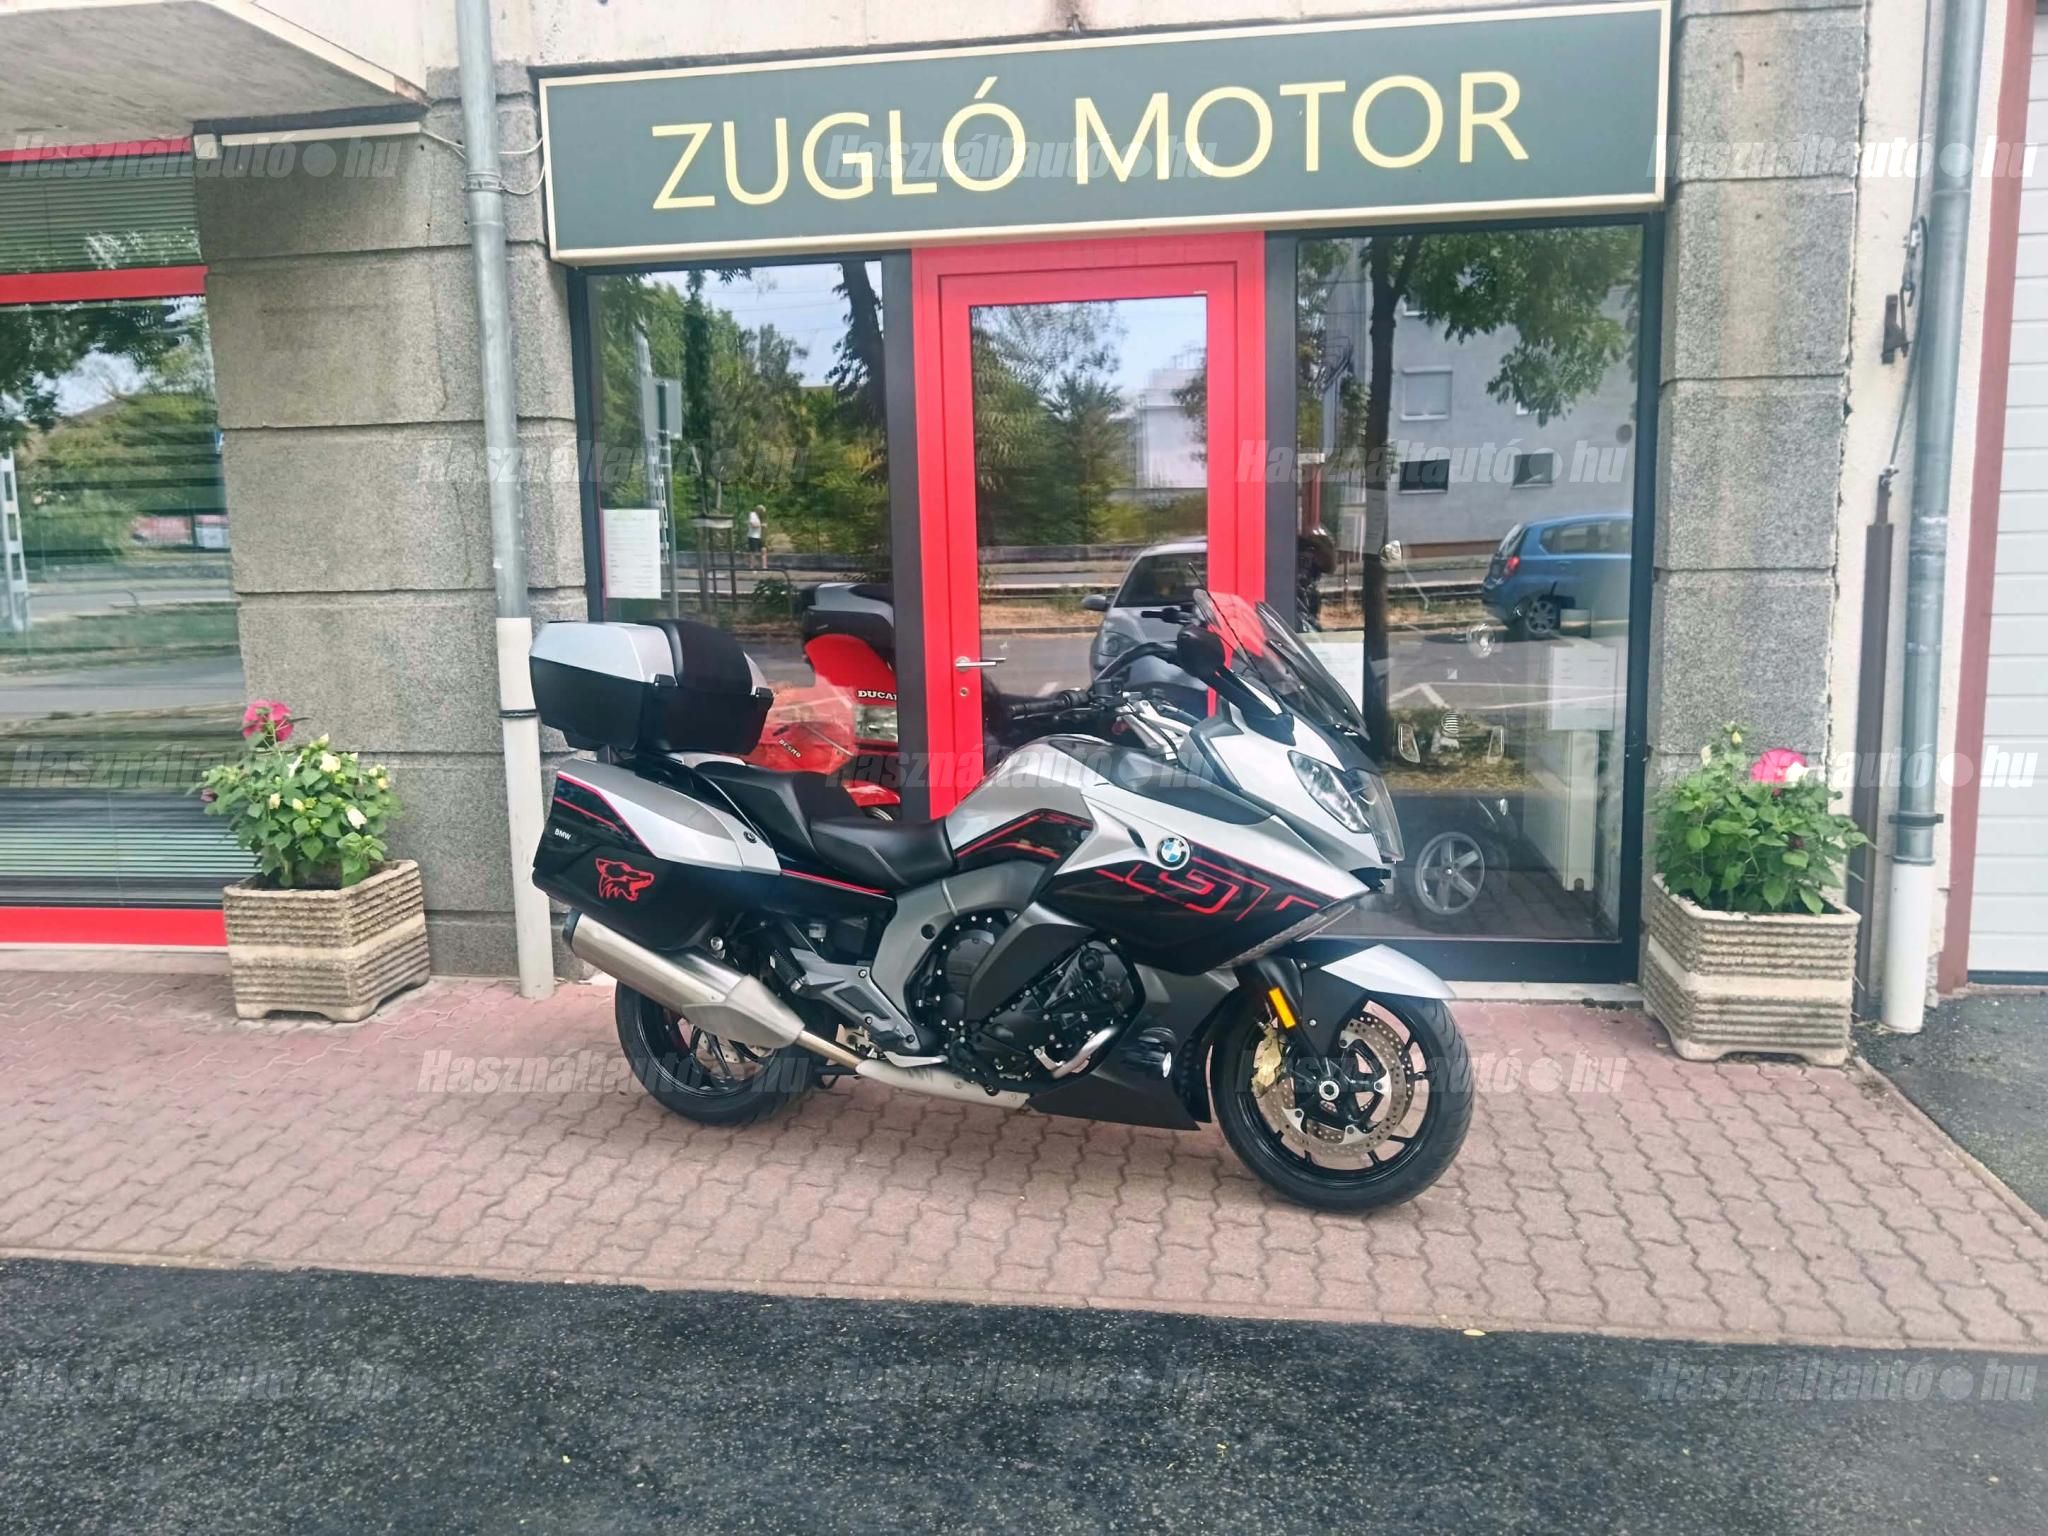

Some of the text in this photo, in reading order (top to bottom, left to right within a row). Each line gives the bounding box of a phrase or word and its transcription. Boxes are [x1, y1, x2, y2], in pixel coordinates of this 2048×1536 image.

[651, 71, 1529, 209] ZUGLÓ MOTOR
[554, 828, 572, 841] BMW
